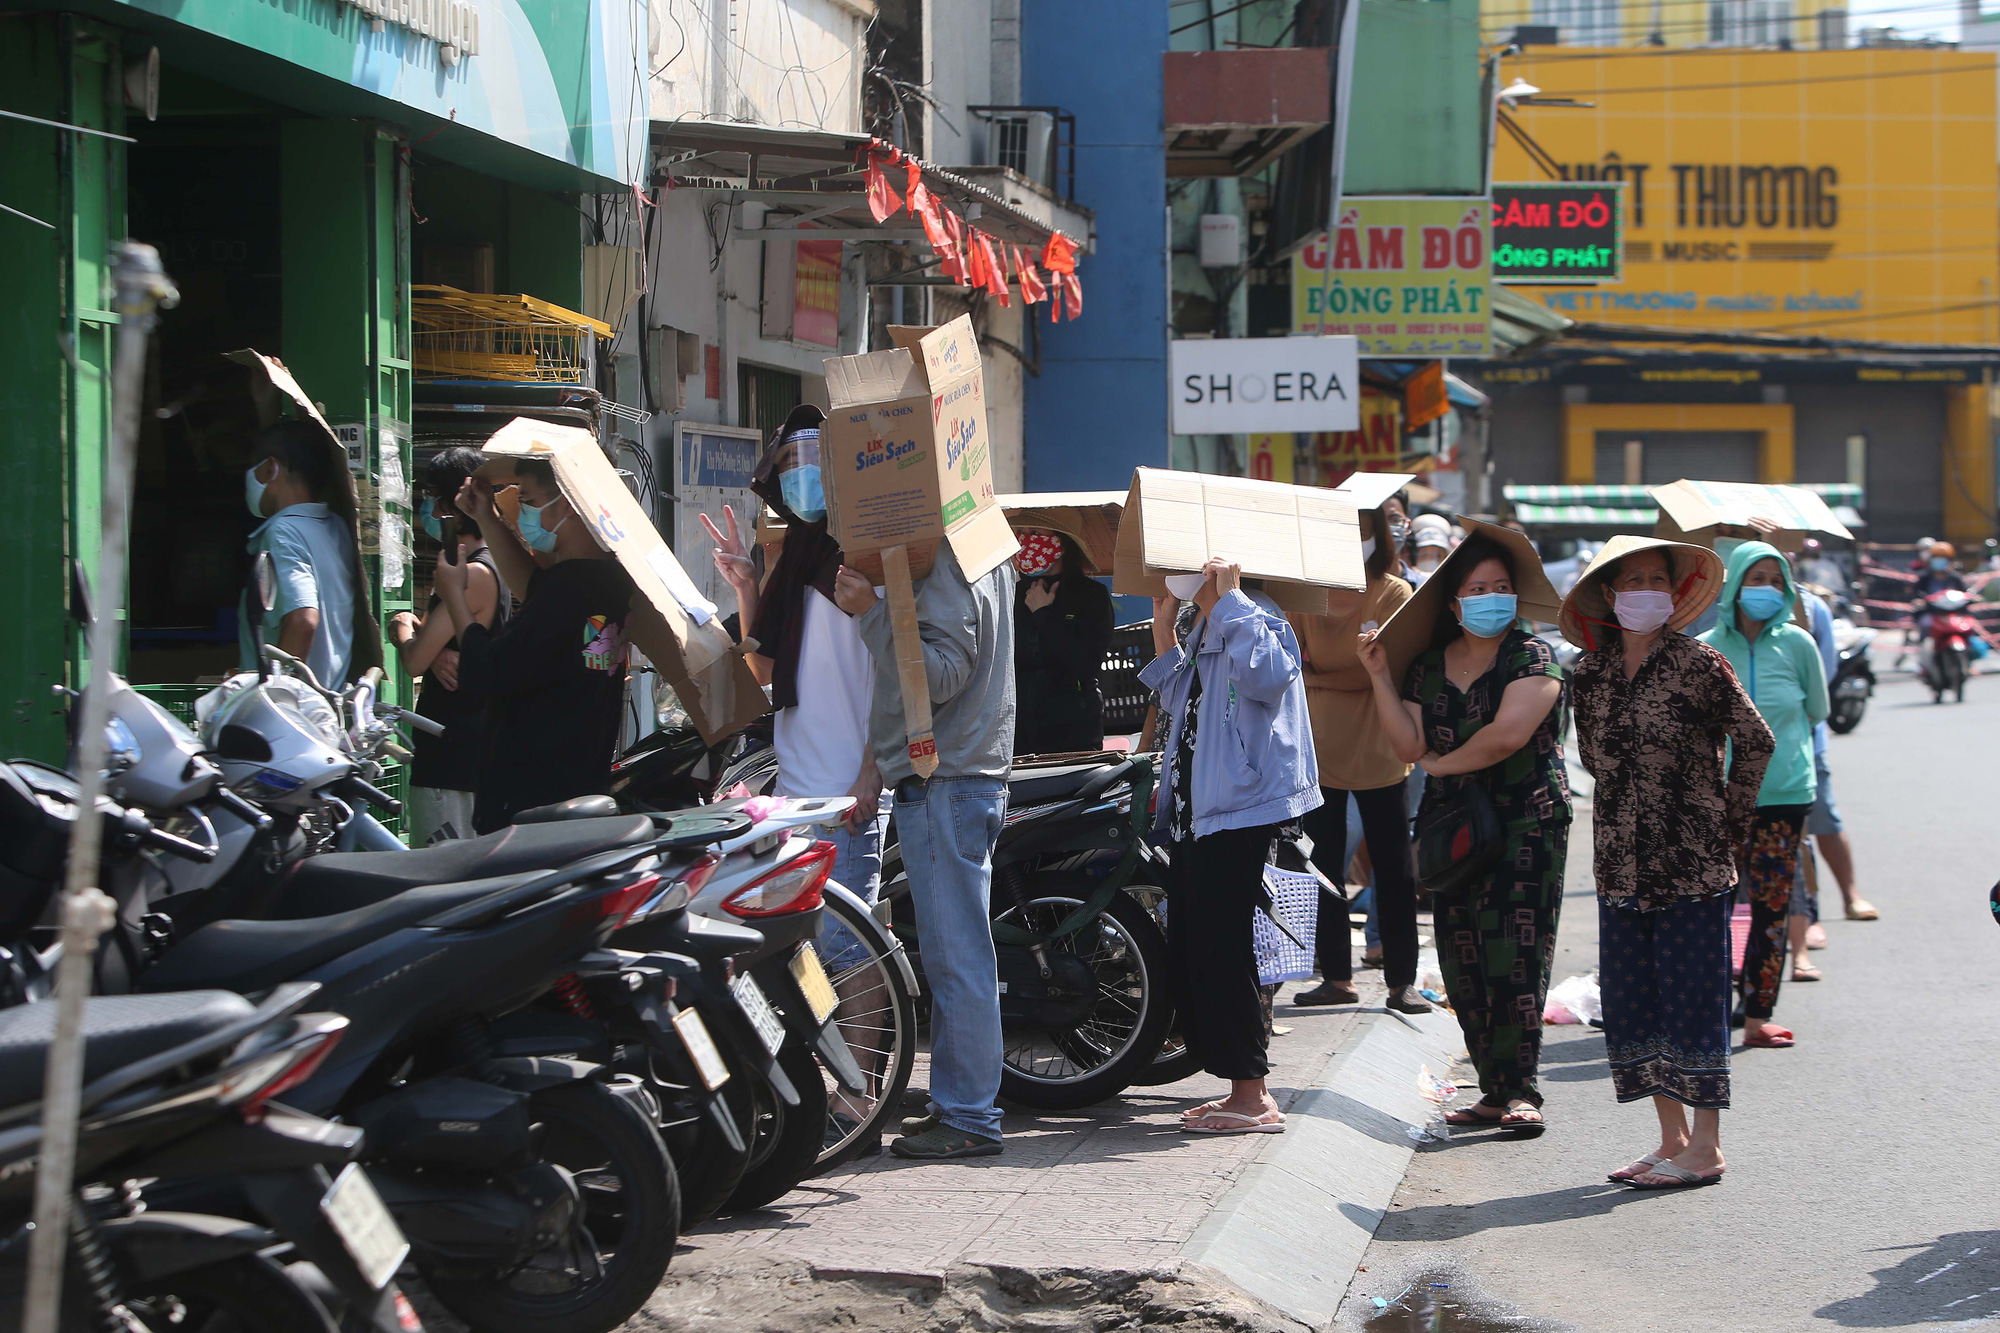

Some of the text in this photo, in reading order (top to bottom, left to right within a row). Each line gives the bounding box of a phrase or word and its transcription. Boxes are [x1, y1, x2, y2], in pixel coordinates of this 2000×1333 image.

[1422, 208, 1483, 270] ĐỒ
[1663, 242, 1740, 261] MUSIC
[1307, 278, 1484, 314] ĐÔNG PHÁT
[1184, 371, 1347, 403] SHOERA
[856, 439, 916, 471] Siêu Sạch
